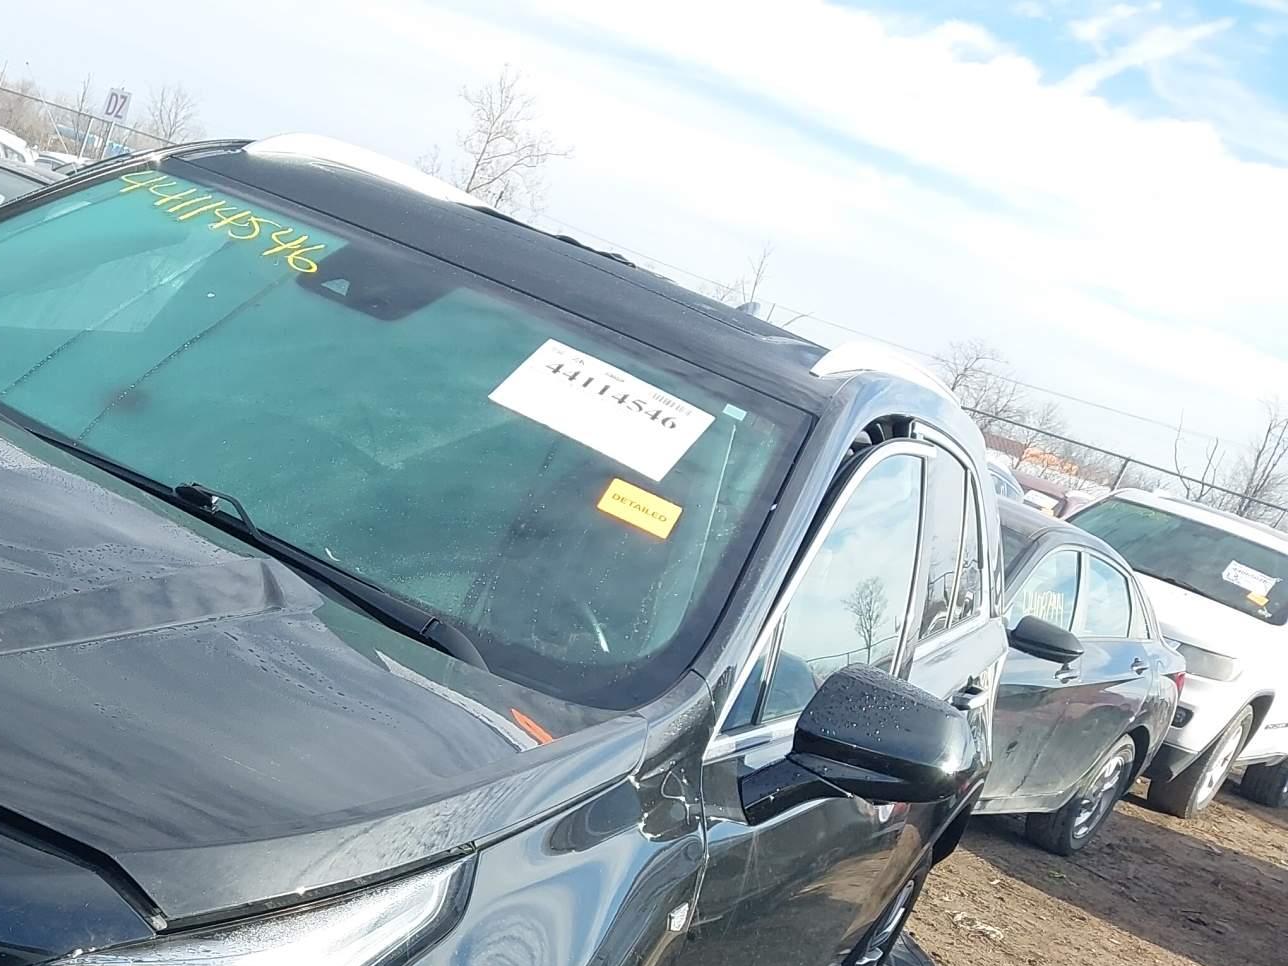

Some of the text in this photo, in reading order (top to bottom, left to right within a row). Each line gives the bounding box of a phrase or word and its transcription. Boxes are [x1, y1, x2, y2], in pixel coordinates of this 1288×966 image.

[119, 170, 318, 273] 44114546
[545, 361, 678, 430] 44114546
[611, 492, 668, 523] DETAILED
